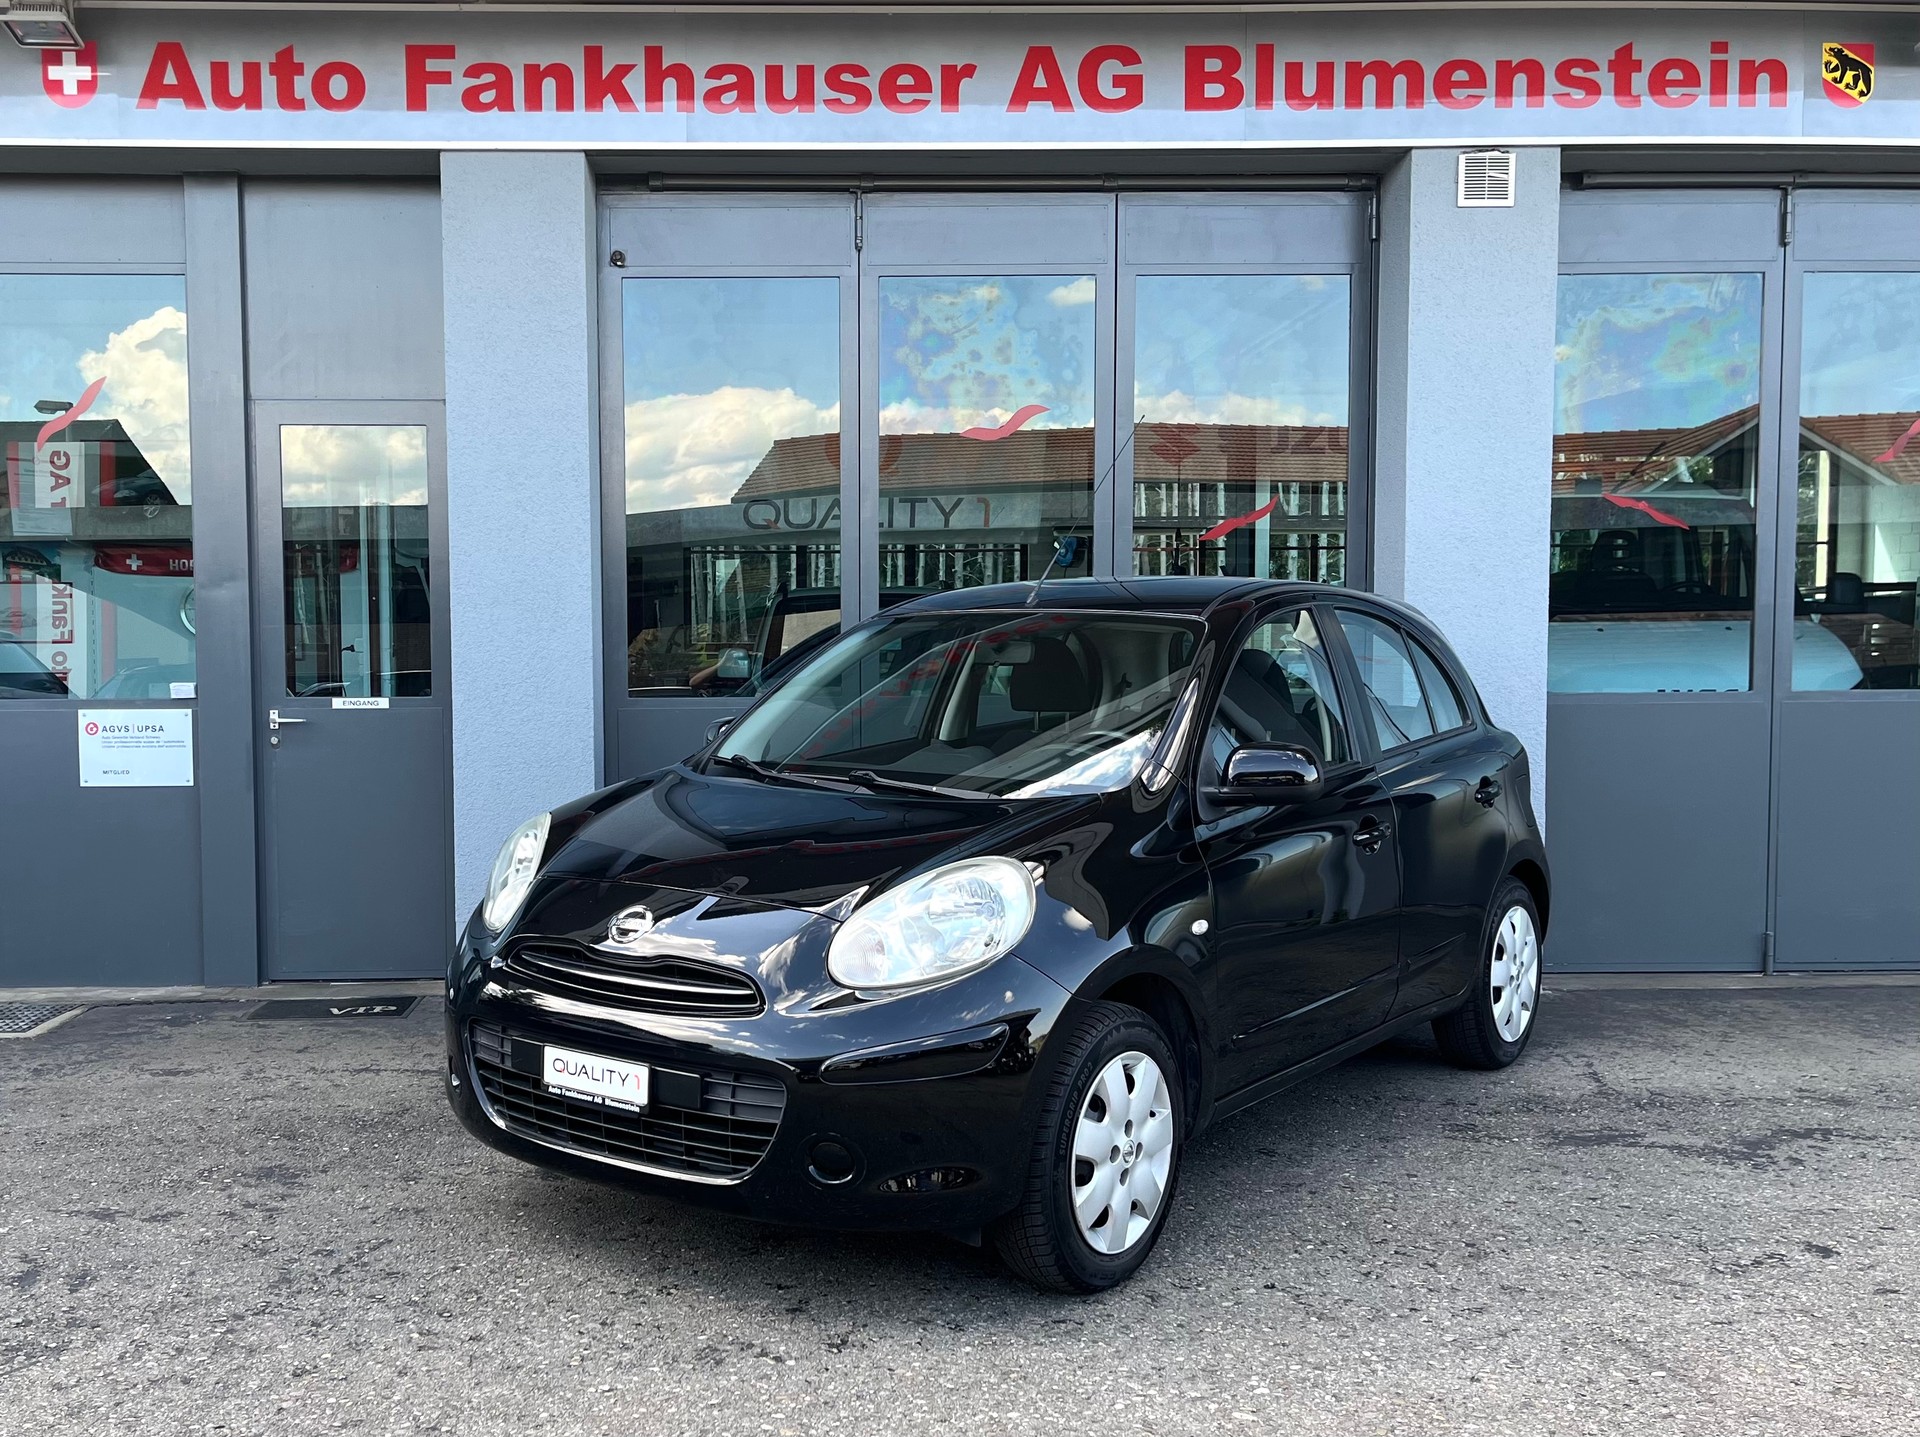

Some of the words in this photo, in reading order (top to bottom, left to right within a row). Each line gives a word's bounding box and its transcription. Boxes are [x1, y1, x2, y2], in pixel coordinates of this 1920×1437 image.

[136, 41, 367, 112] Auto
[404, 44, 978, 114] Fankhauser
[1005, 44, 1145, 114] AG
[1183, 41, 1789, 113] Blumenstein
[743, 497, 965, 530] QUAITY
[976, 497, 991, 528] 1
[101, 725, 130, 733] AGVS
[137, 725, 165, 733] UPSA
[329, 1005, 398, 1015] VIP
[552, 1057, 630, 1087] QUALITY
[634, 1074, 641, 1090] 1
[548, 1085, 561, 1094] Auto
[562, 1088, 593, 1102] Fankhauser
[594, 1095, 603, 1104] AG
[604, 1098, 640, 1113] Blumenstein
[1059, 1090, 1079, 1156] SUPERGRIP
